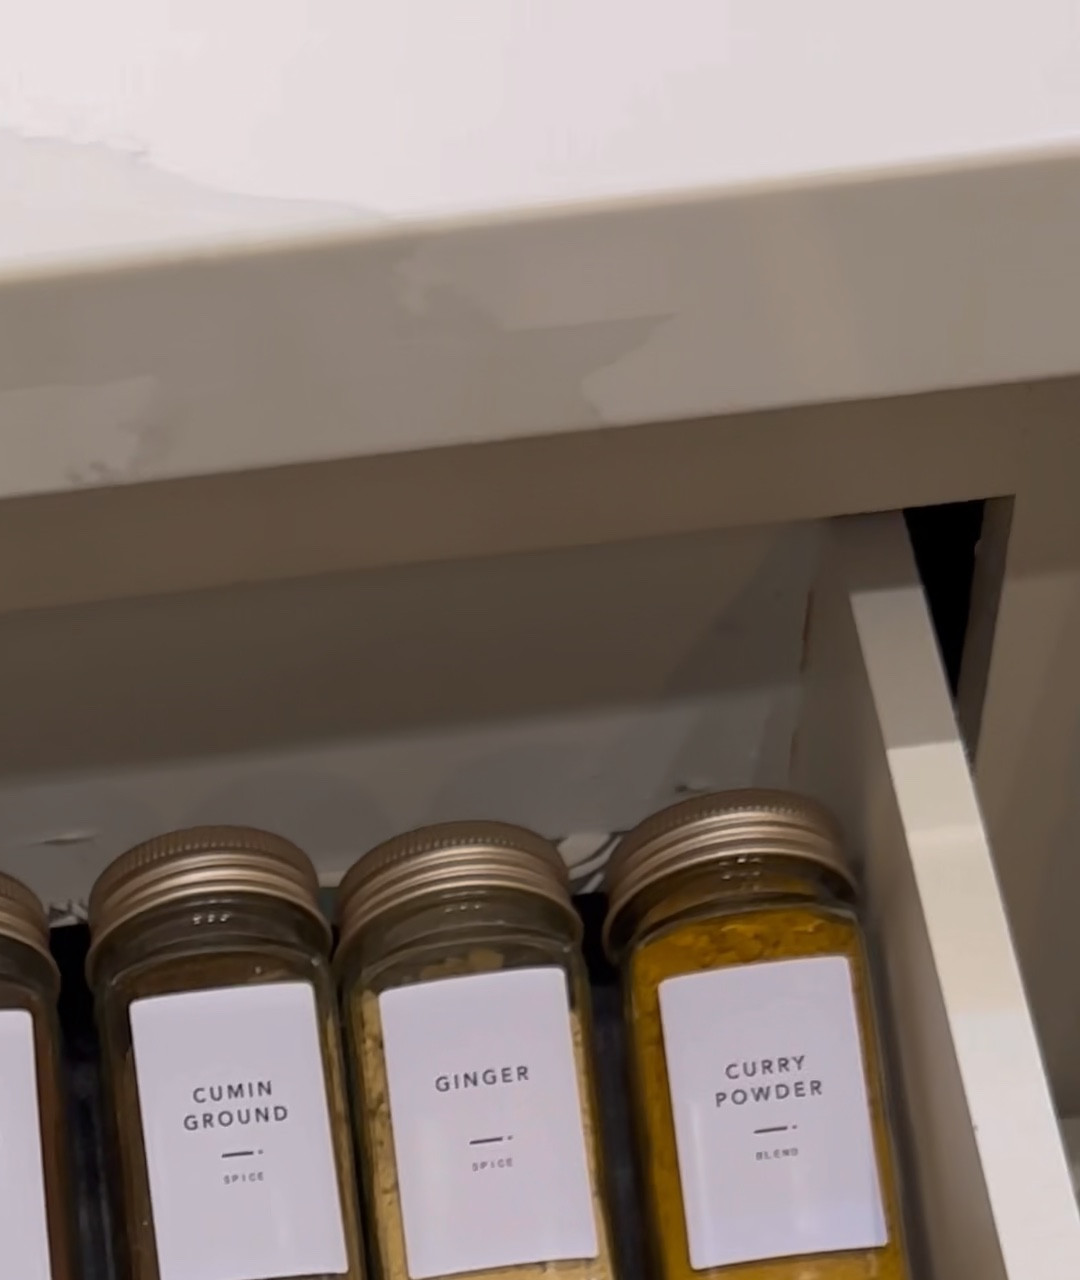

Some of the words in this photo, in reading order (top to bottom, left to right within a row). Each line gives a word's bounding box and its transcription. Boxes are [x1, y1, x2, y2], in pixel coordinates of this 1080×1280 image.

[434, 1065, 529, 1093] GINGER
[724, 1054, 805, 1080] CURRY
[192, 1080, 273, 1104] CUMIN
[714, 1079, 823, 1108] POWDER
[183, 1105, 289, 1132] GROUND
[471, 1156, 513, 1173] SPICE
[755, 1147, 799, 1161] BLEND
[222, 1171, 264, 1185] SPICE
